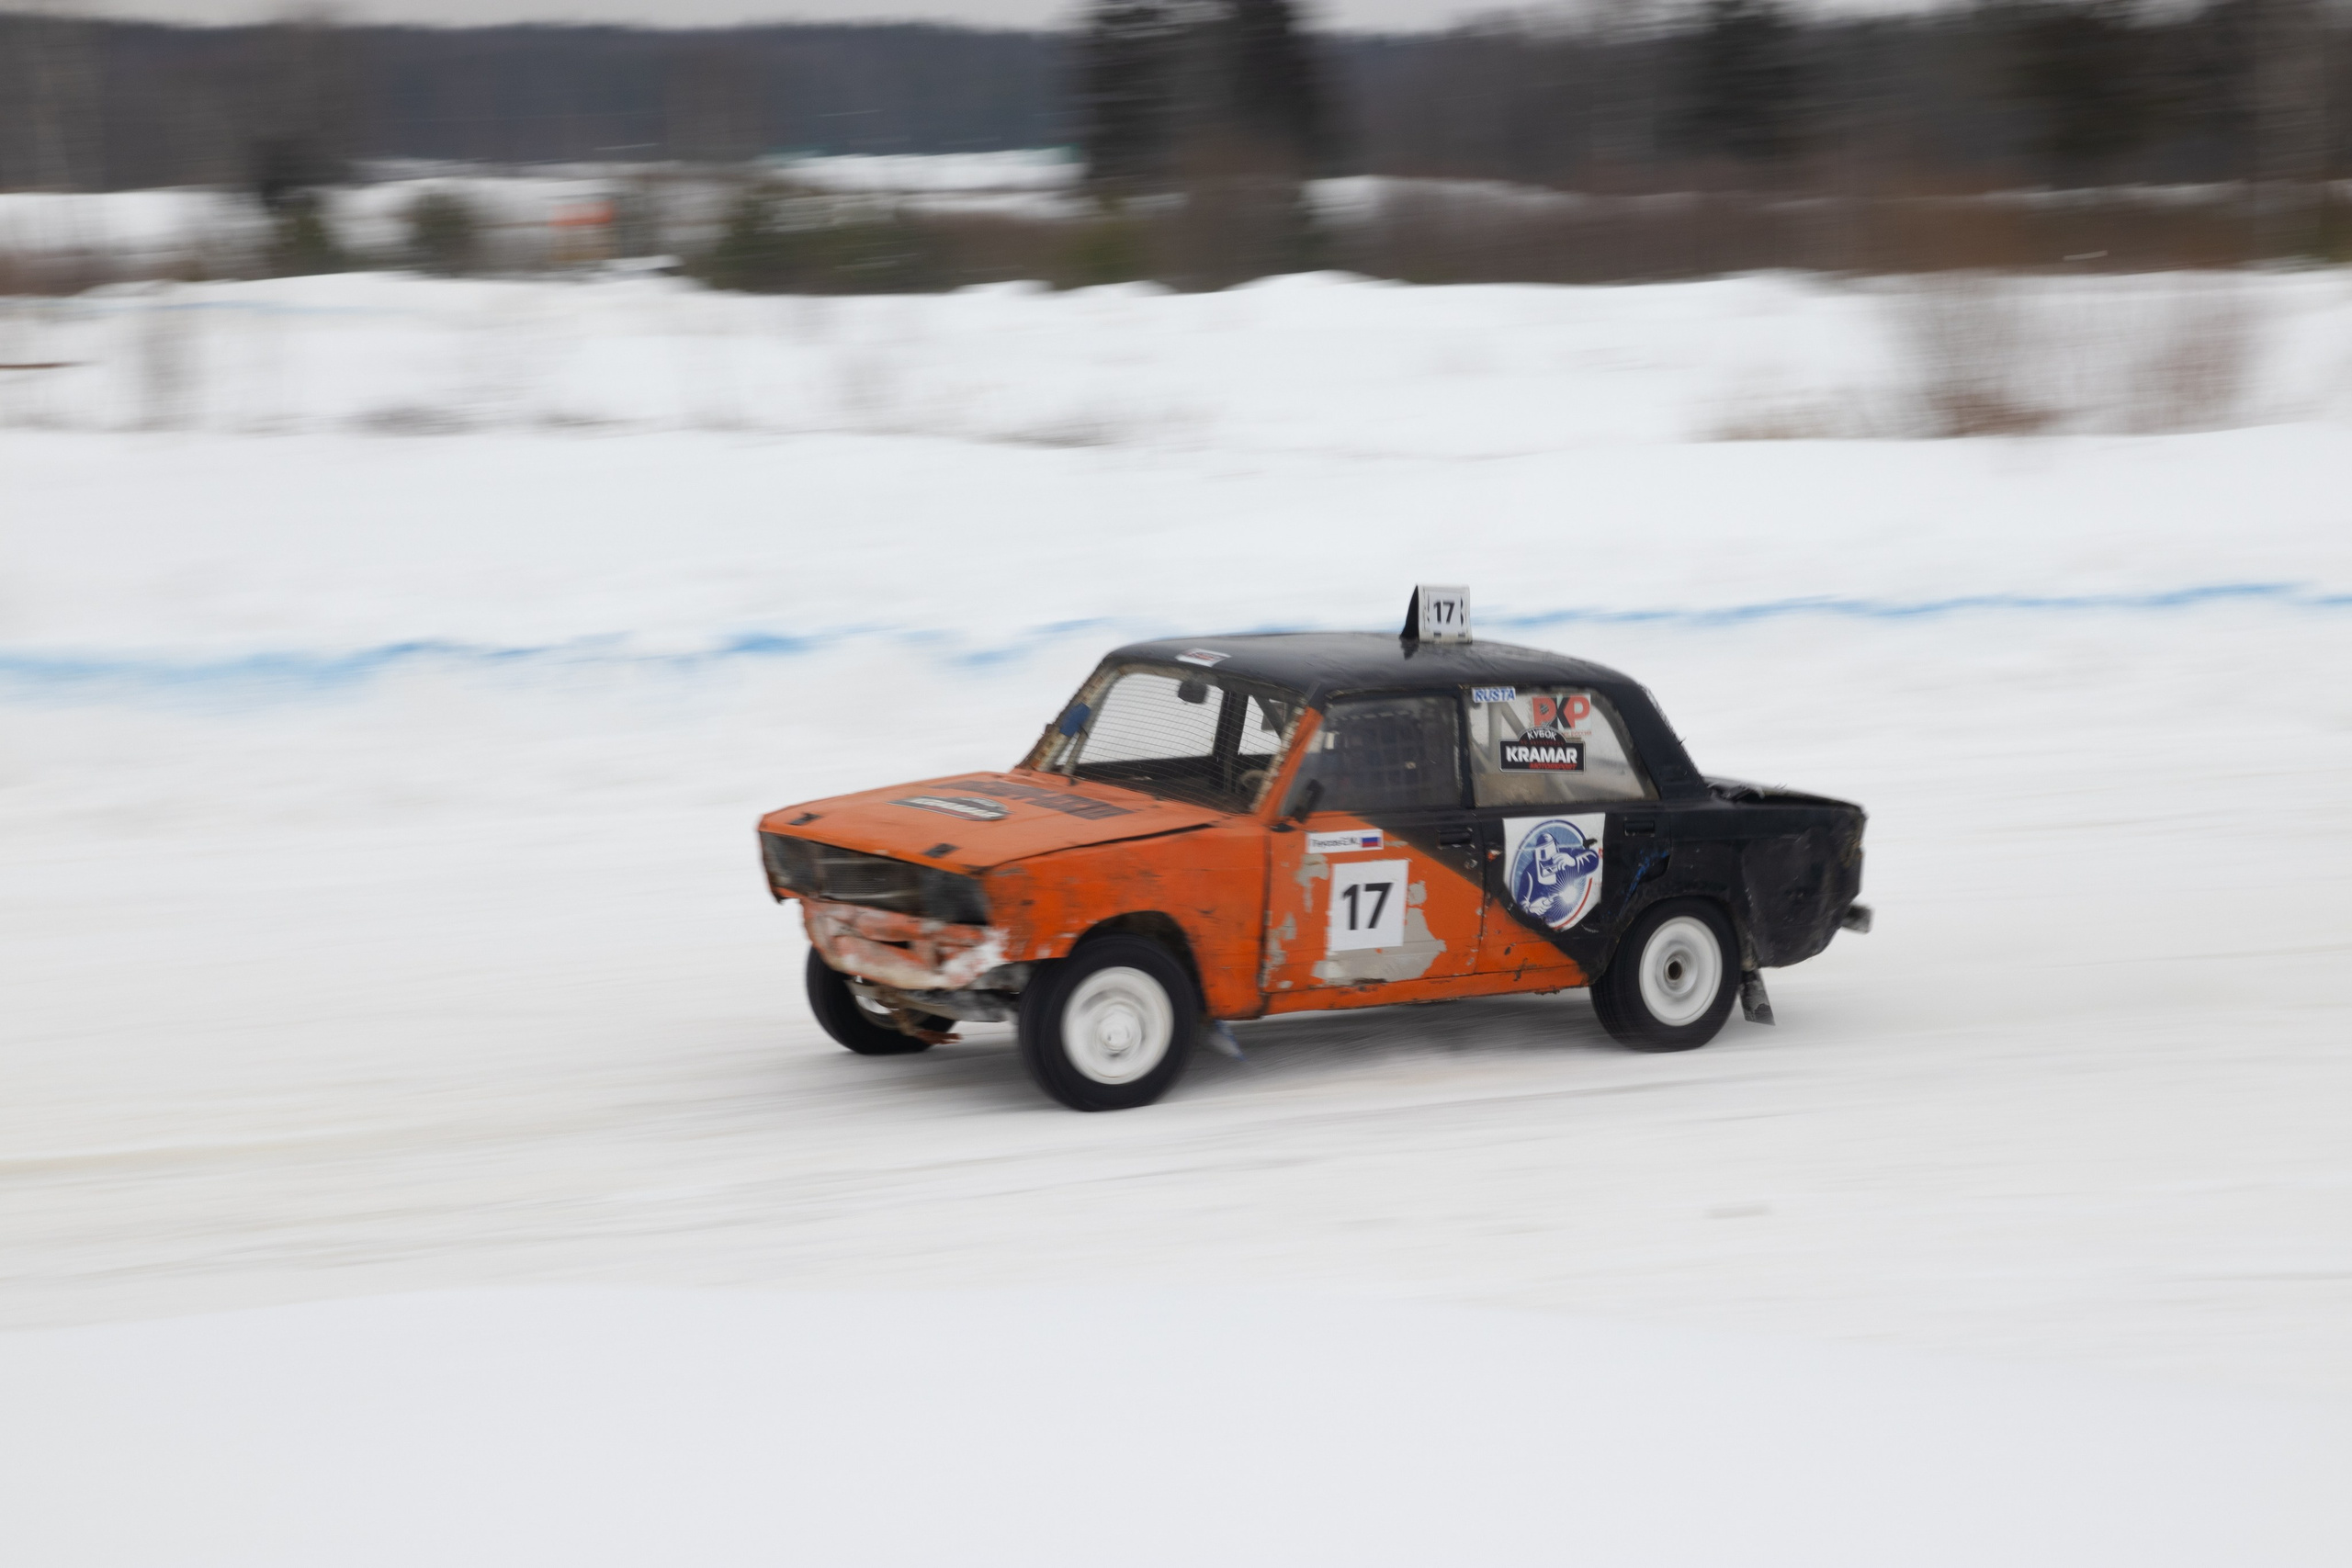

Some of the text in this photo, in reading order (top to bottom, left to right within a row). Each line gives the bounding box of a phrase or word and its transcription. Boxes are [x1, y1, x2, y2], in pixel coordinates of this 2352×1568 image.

[1433, 599, 1455, 625] 17
[1474, 688, 1515, 702] RUSTA
[1505, 745, 1577, 764] KRAMAR
[1340, 882, 1395, 931] 17
